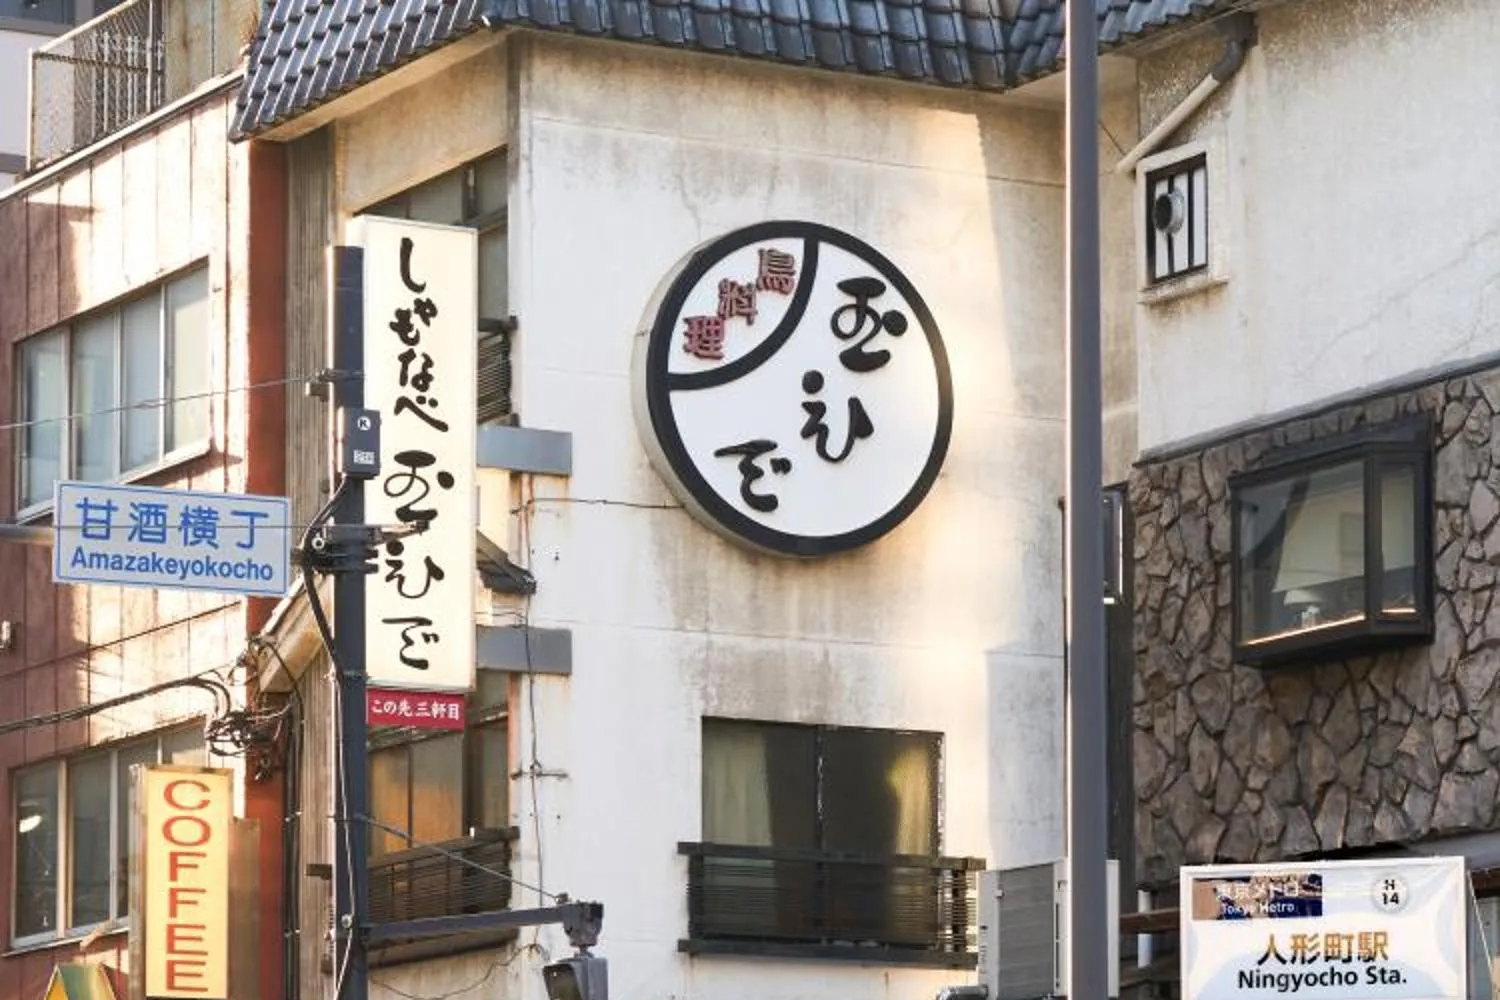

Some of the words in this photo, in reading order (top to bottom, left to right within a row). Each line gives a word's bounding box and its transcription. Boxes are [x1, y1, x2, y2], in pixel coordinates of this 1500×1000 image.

[75, 495, 270, 550] 甘酒横丁
[71, 546, 273, 582] Amazakeyokocho
[371, 697, 461, 721] この先三軒目
[163, 778, 211, 993] COFFEE
[1381, 893, 1400, 905] 14
[1257, 931, 1390, 966] 人形町駅
[1238, 968, 1359, 993] Ningyocho
[1365, 965, 1408, 986] Sta.
